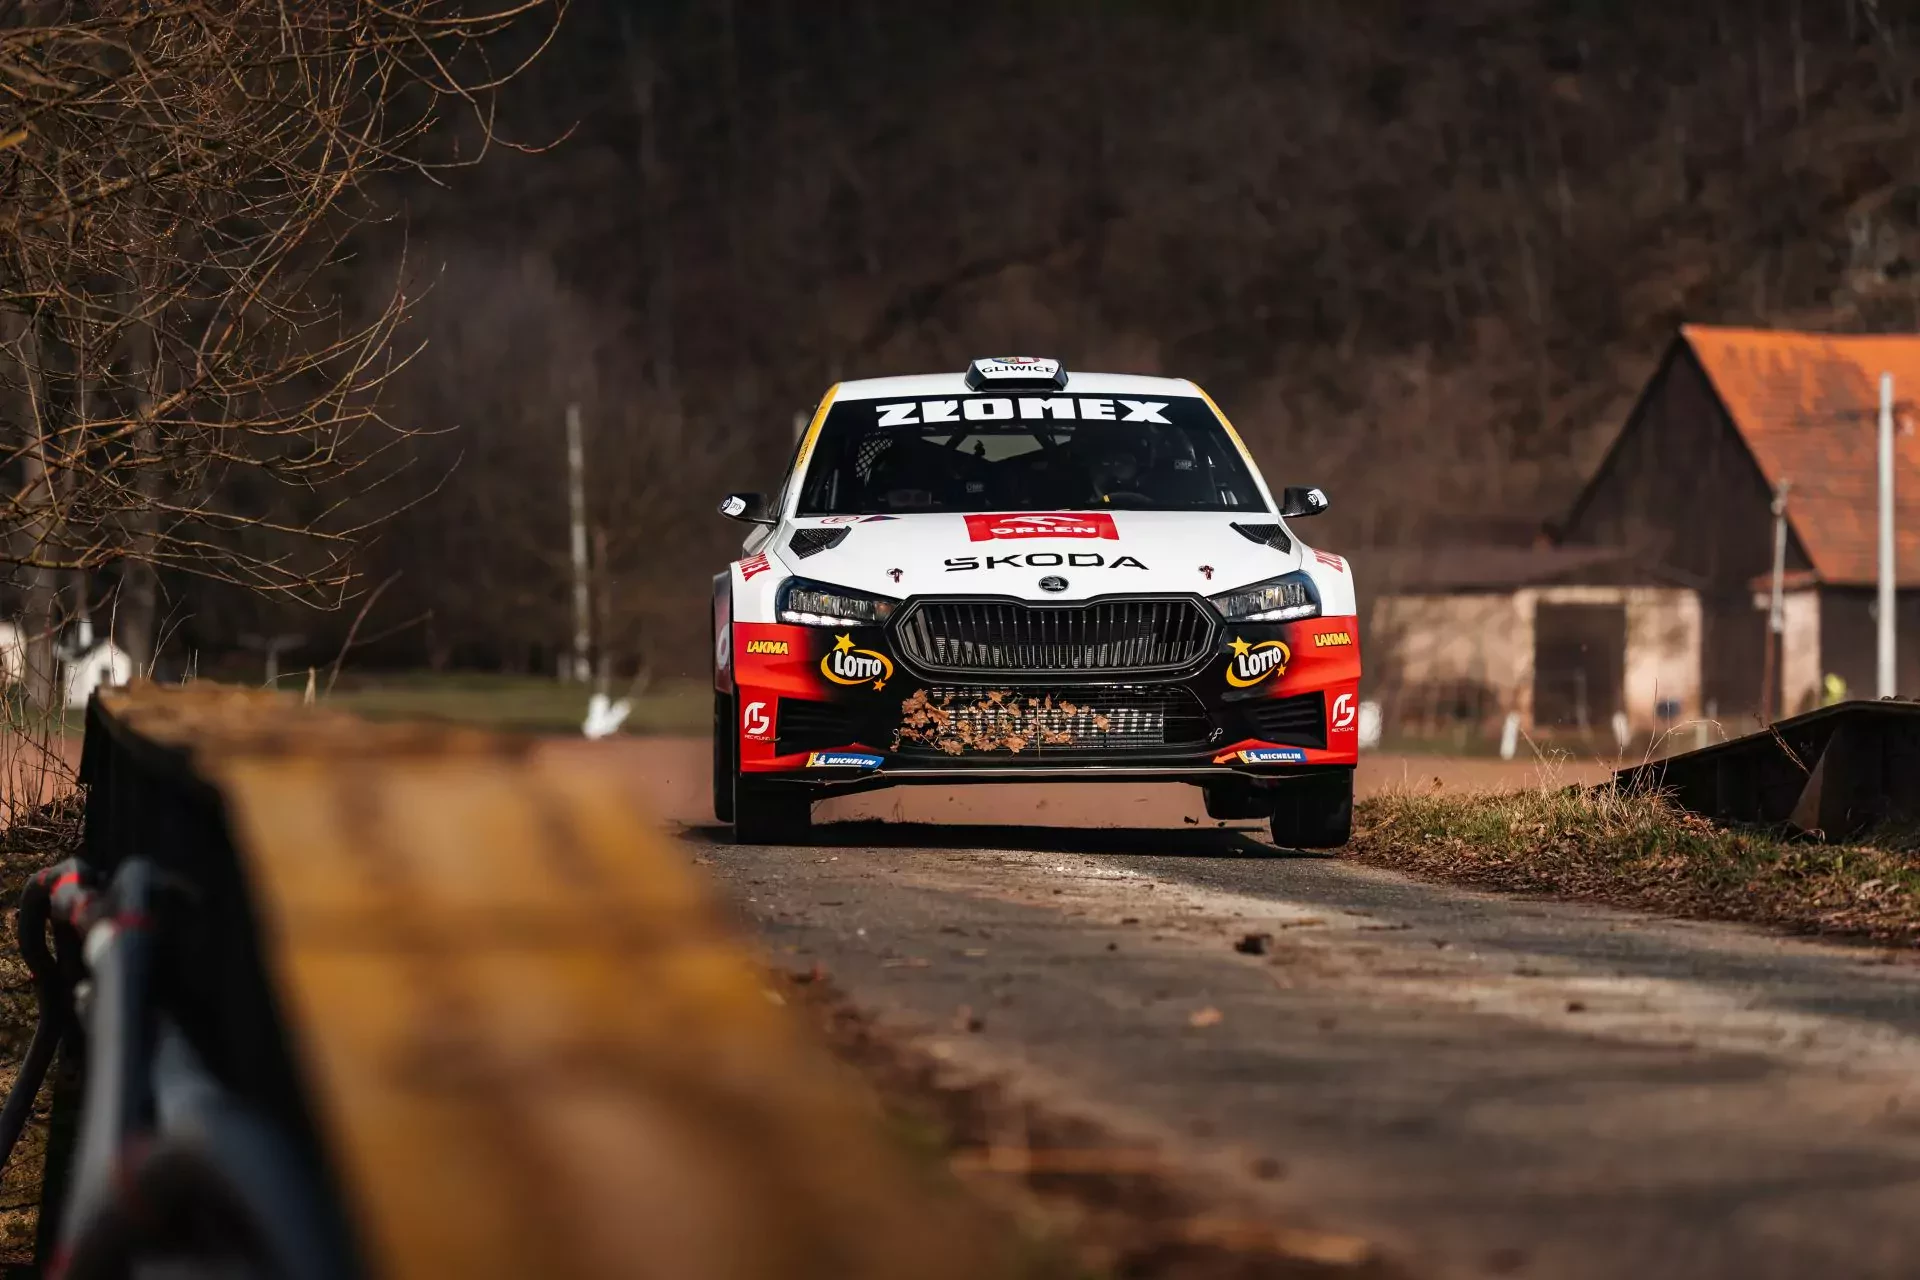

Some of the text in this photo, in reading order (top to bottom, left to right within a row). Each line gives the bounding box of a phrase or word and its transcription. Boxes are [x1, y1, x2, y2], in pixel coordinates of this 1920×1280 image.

[981, 364, 1055, 375] GLIWICE
[875, 398, 1173, 427] ZŁOMEX
[990, 526, 1097, 535] ORLEN
[1314, 633, 1351, 647] LAKMA
[746, 641, 789, 655] LAKMA
[834, 650, 882, 678] LOTTO
[1238, 647, 1281, 678] LOTTO
[826, 757, 877, 766] MICHELIN
[1260, 752, 1301, 760] MICHELIN
